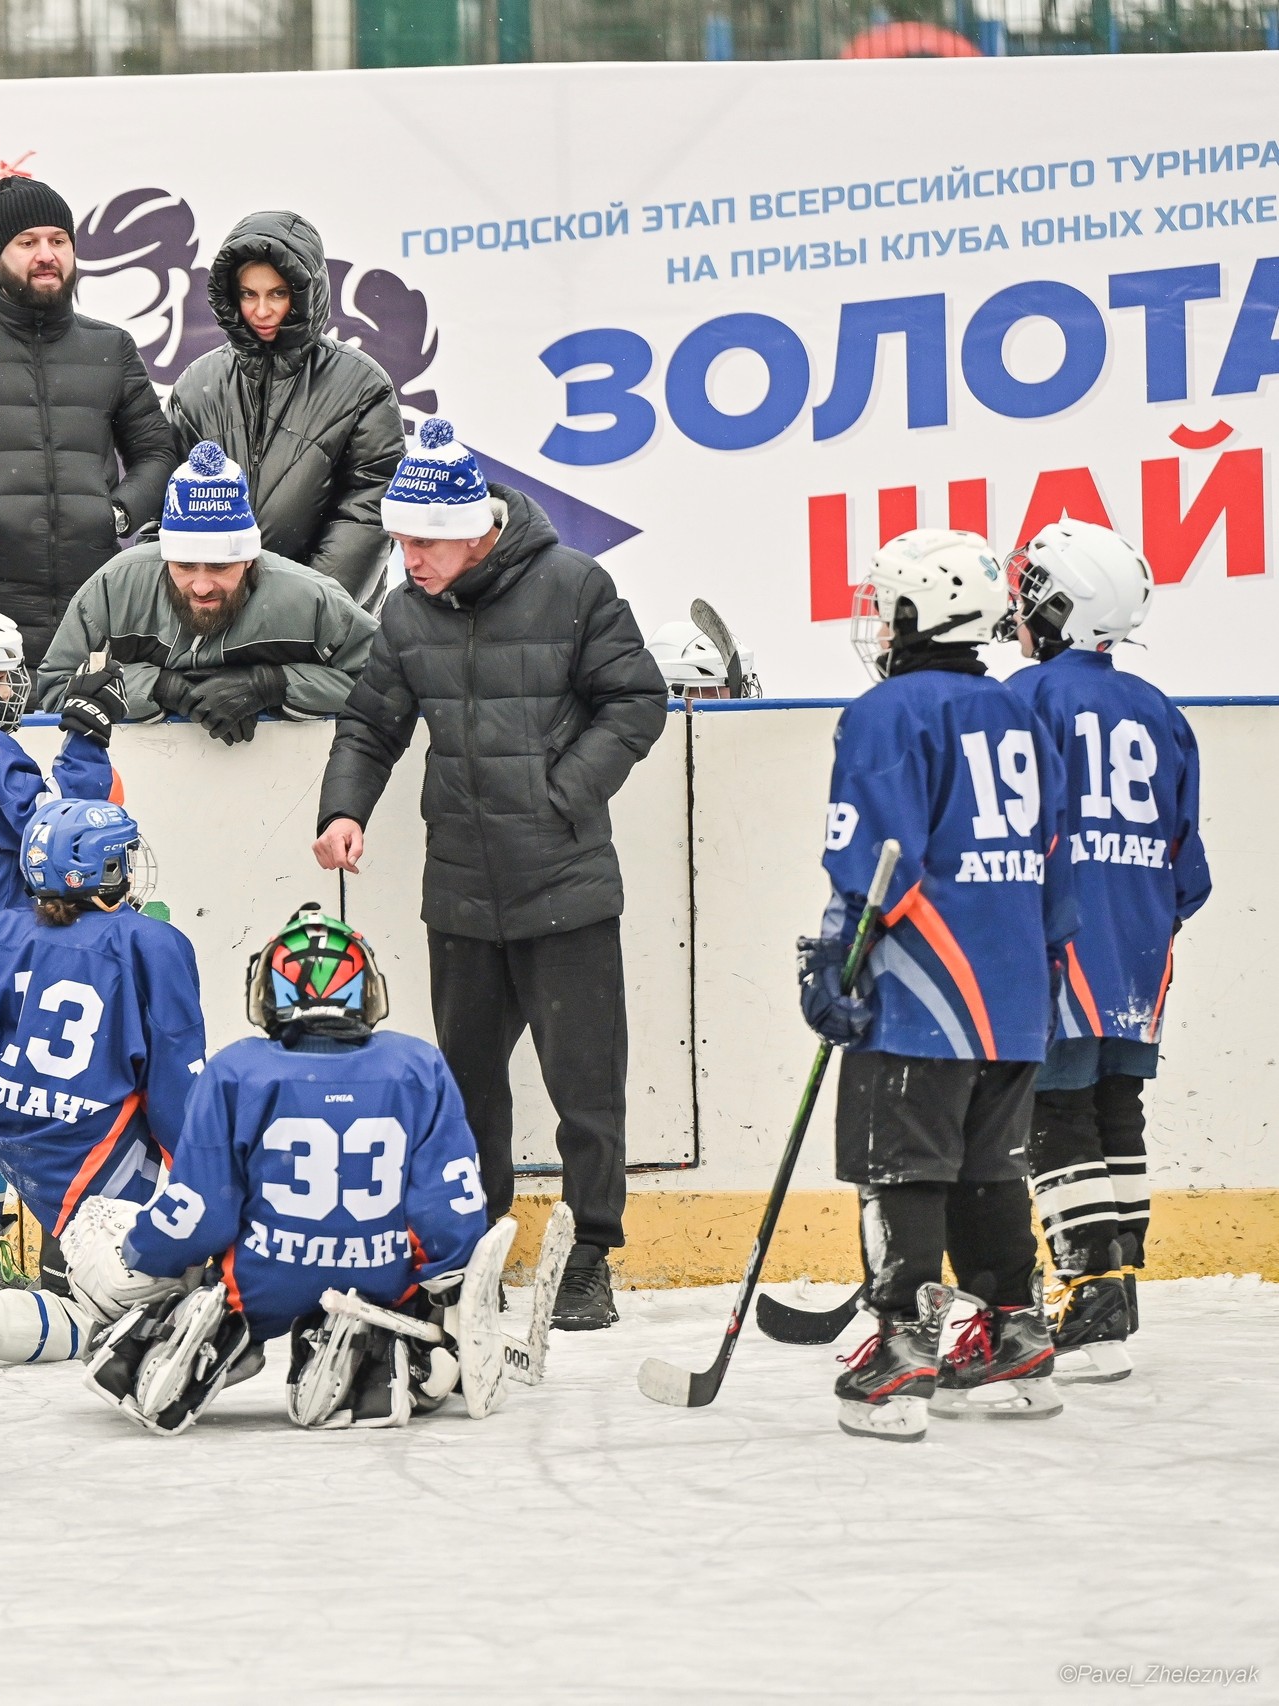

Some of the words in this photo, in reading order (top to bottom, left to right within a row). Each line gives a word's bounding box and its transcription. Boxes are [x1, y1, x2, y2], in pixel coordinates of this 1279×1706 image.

[401, 201, 629, 257] ГОРОДСКОЙ
[642, 197, 735, 233] ЭТАП
[750, 159, 1095, 222] ВСЕРОССИЙСКОГО
[1107, 140, 1279, 183] ТУРНИРА
[666, 255, 718, 284] НА
[731, 240, 867, 279] ПРИЗЫ
[881, 224, 1009, 262] КЛУБА
[1021, 209, 1142, 247] ЮНЫХ
[1154, 195, 1277, 234] ХОККЕ
[189, 487, 239, 498] ЗОЛОТАЯ
[394, 476, 437, 492] ШАЙБА
[401, 465, 450, 481] ЗОЛОТАЯ
[188, 499, 232, 511] ШАЙБА
[960, 729, 1040, 839] 19
[1074, 711, 1160, 824] 18
[262, 1117, 407, 1221] 33
[442, 1152, 488, 1215] 3
[244, 1220, 412, 1268] АТЛАНТ
